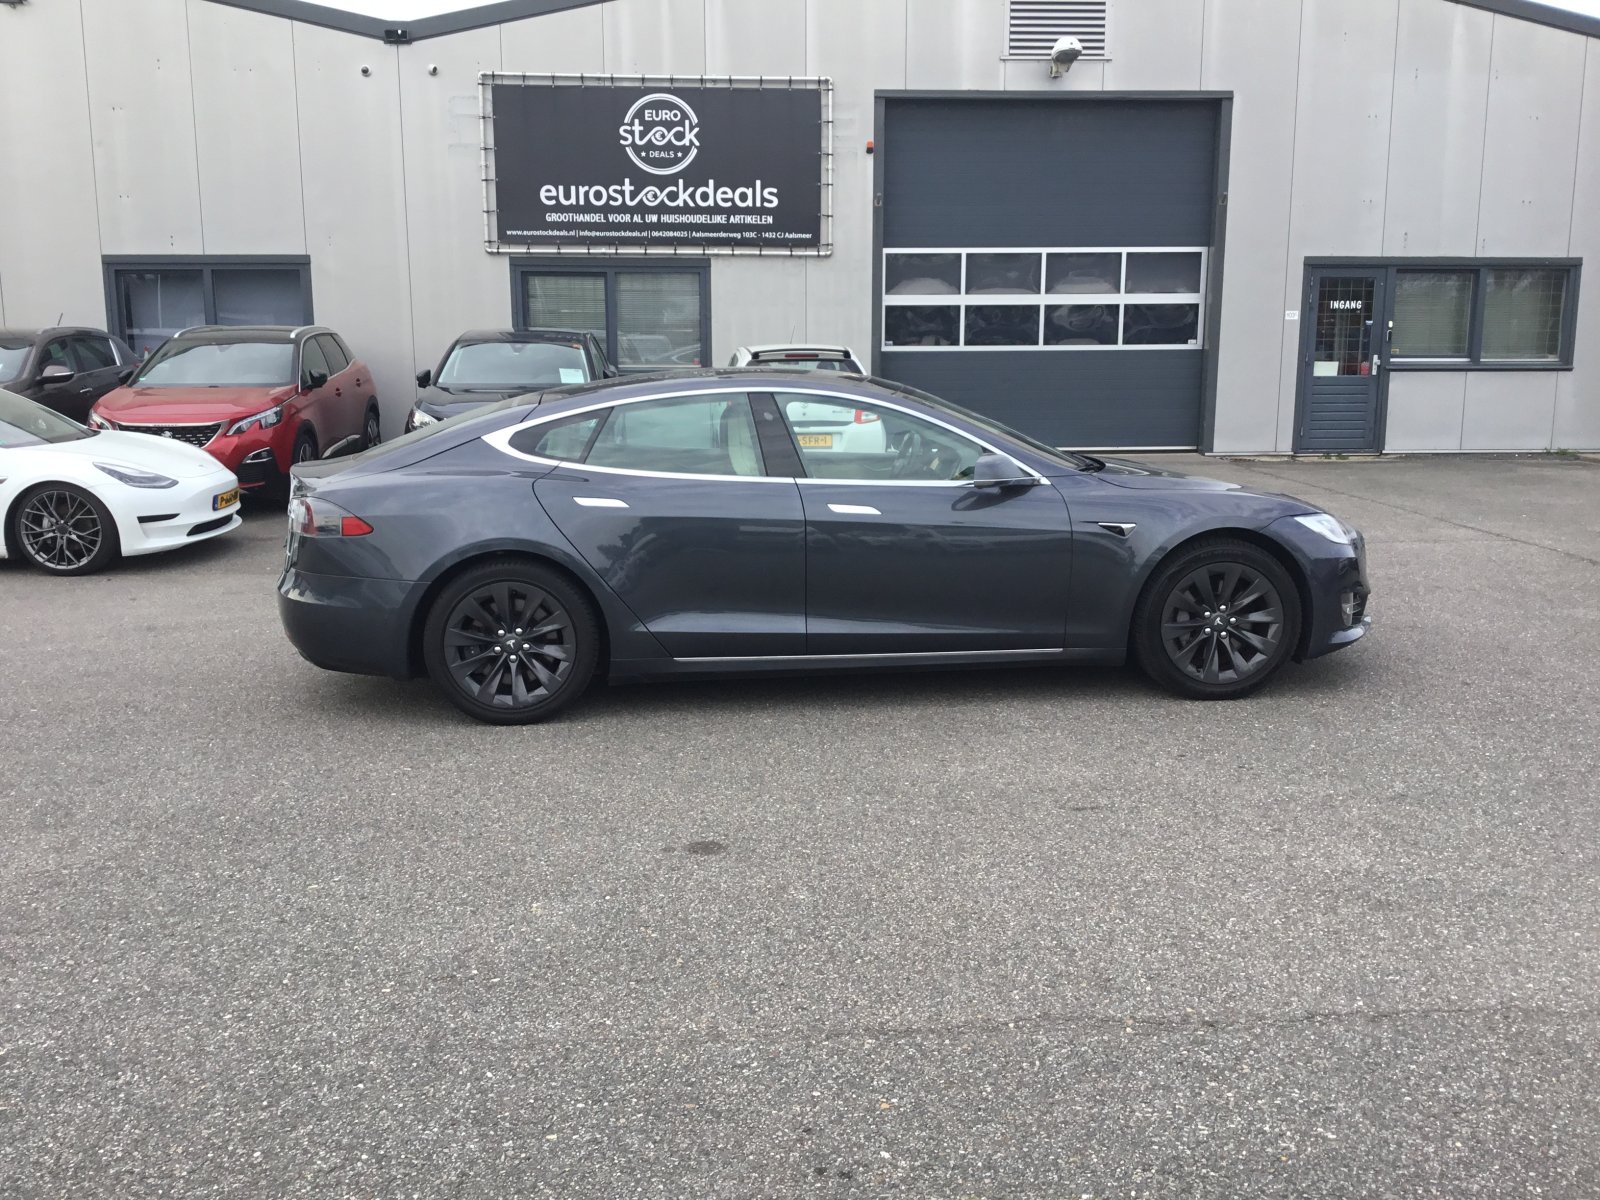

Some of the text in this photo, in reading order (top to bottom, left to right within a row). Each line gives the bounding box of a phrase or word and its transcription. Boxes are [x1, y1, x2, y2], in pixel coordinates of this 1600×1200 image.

[644, 109, 681, 121] EURO
[619, 118, 700, 146] stock
[649, 150, 675, 158] DEALS
[539, 178, 779, 207] eurostockdeals
[545, 212, 773, 224] GROOTHANDEL VOOR AL UW HUISHOUDELIJKE ARTIKELEN
[579, 229, 648, 237] info@eurostockdeals.nl
[651, 230, 688, 238] 0642084025
[691, 231, 742, 240] Aalsmeerderweg
[742, 231, 757, 239] 103C
[777, 232, 785, 240] CJ
[785, 232, 813, 240] Aalsmeer
[1330, 300, 1362, 309] INGANG
